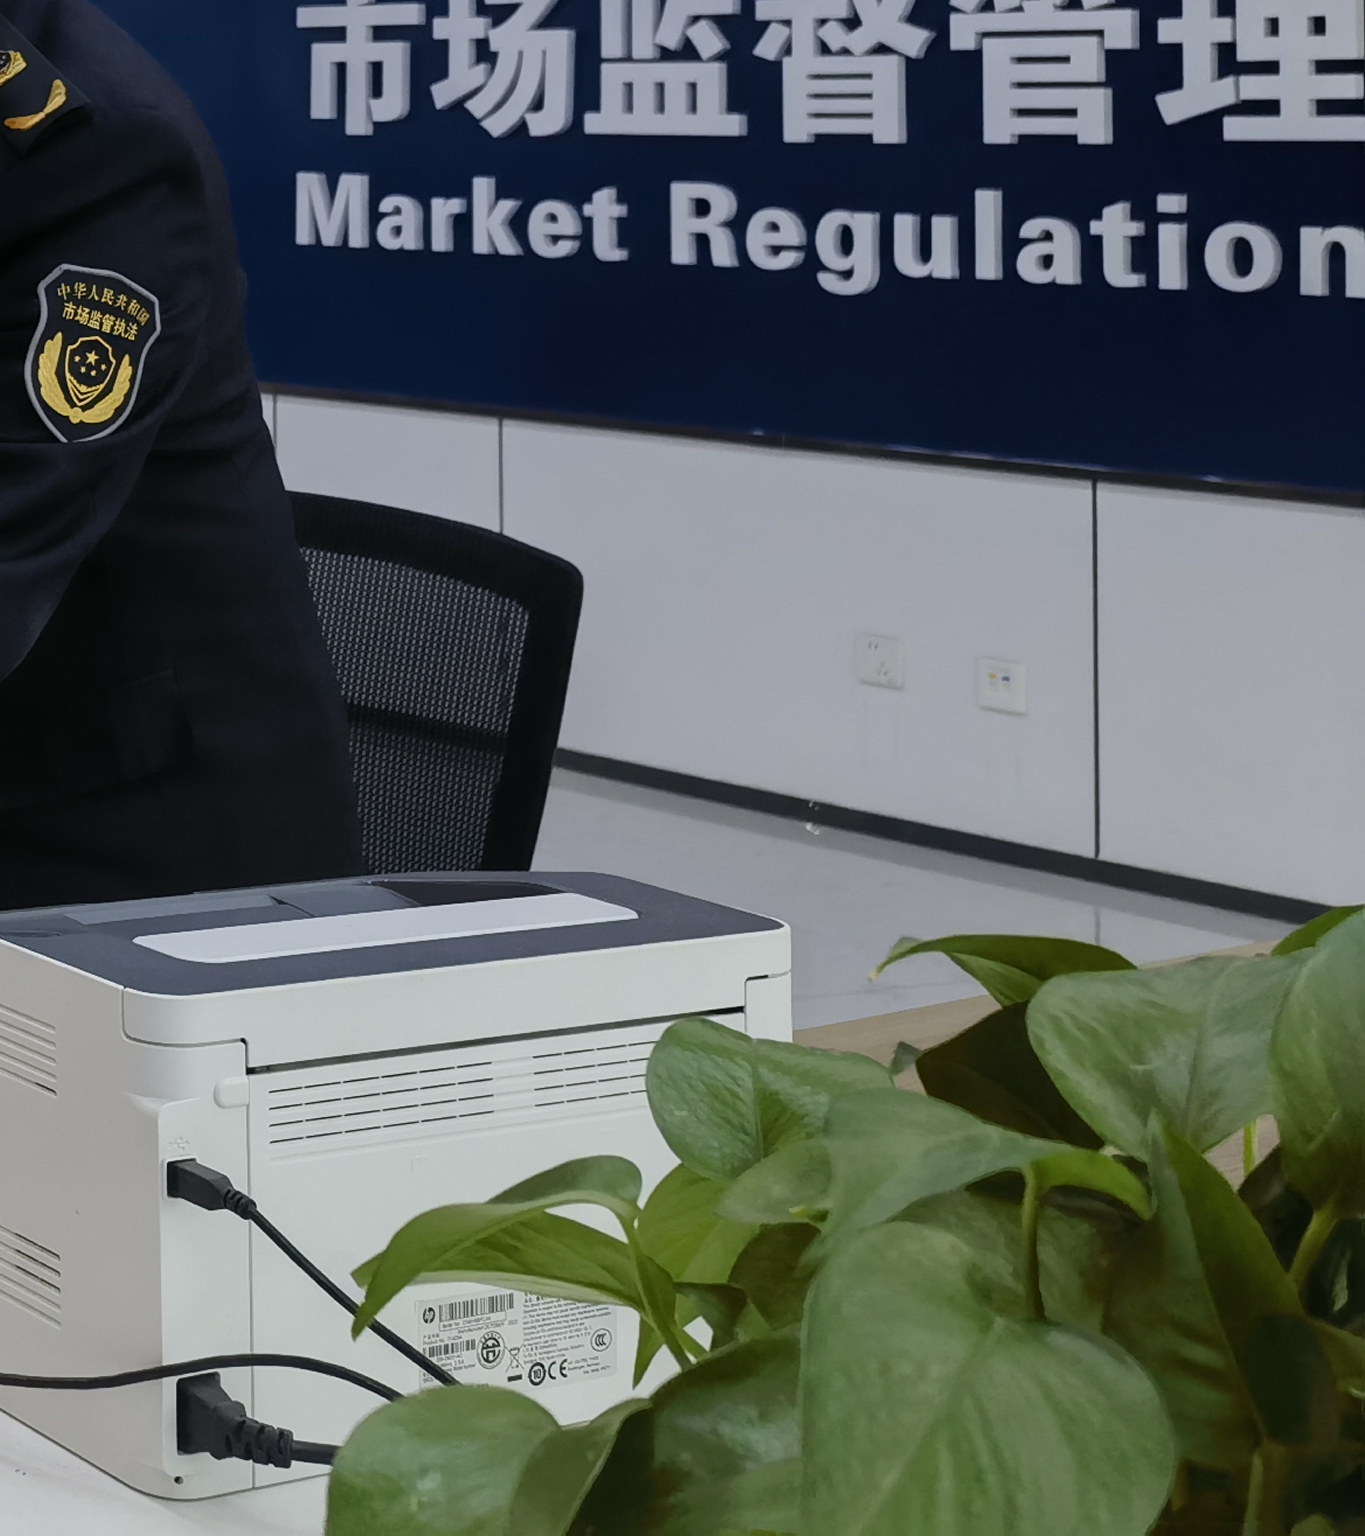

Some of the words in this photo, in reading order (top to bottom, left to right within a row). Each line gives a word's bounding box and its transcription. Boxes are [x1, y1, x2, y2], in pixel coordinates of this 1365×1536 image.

[293, 170, 630, 263] Market
[670, 180, 1365, 300] Regulation
[57, 282, 151, 327] 中华人民共和国
[62, 302, 139, 342] 市场监管执法
